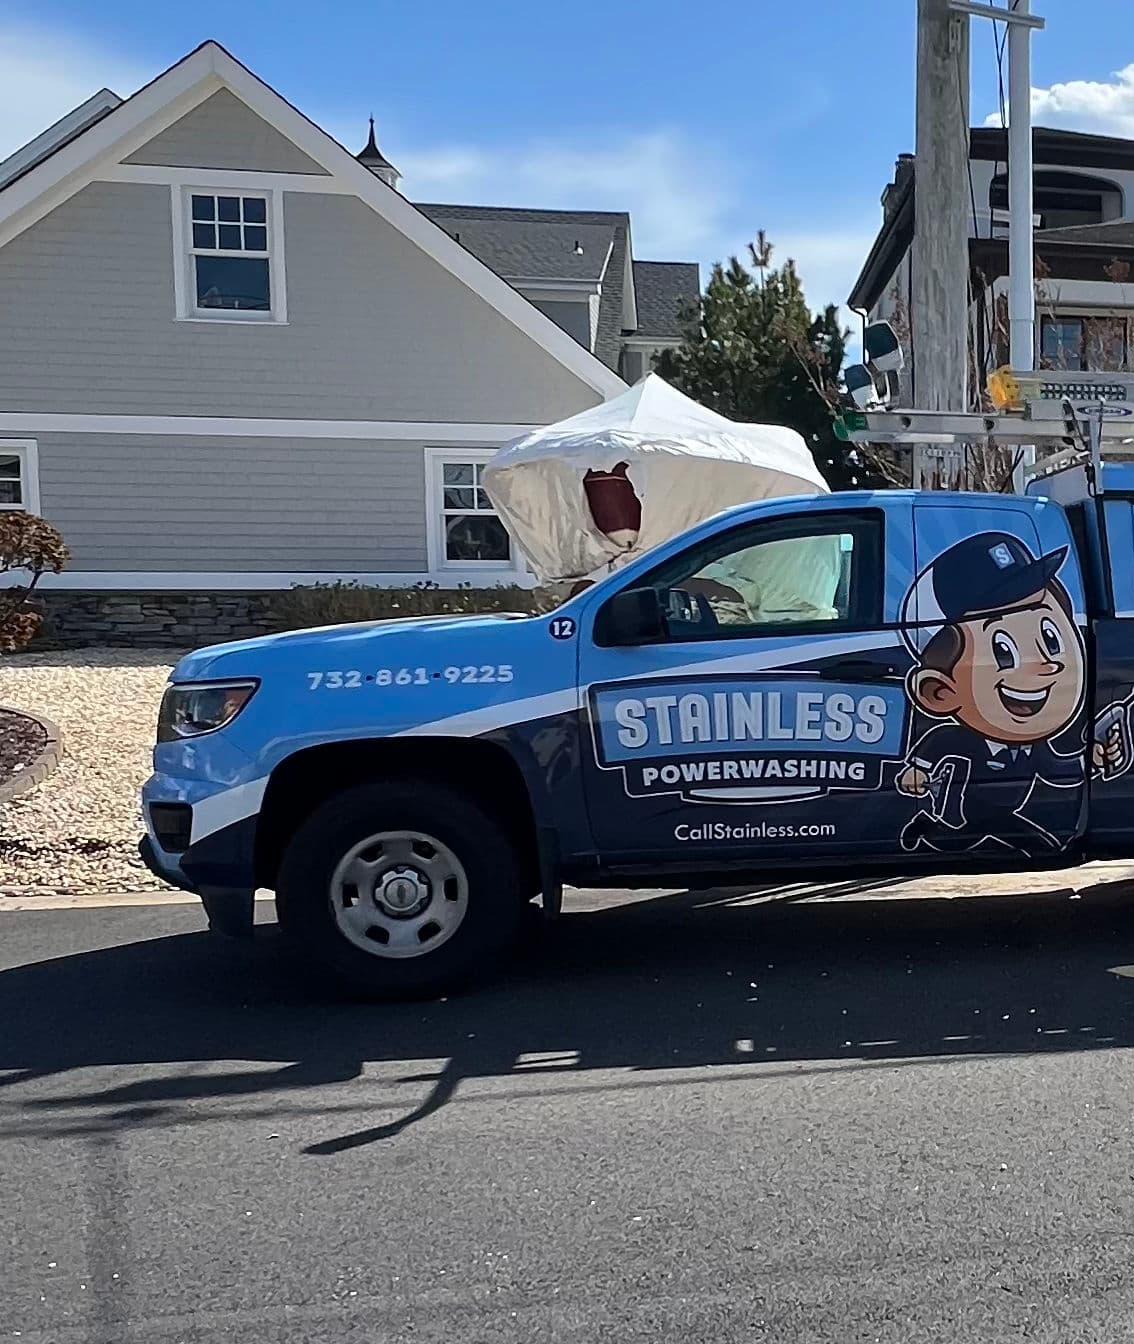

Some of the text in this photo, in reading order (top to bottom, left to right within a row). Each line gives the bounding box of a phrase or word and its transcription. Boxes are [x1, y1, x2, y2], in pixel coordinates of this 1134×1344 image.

[995, 548, 1010, 564] S
[552, 620, 573, 636] 12
[614, 691, 888, 749] STAINLESS
[642, 759, 866, 786] POWERWASHING
[674, 821, 836, 842] CallStainless.com
